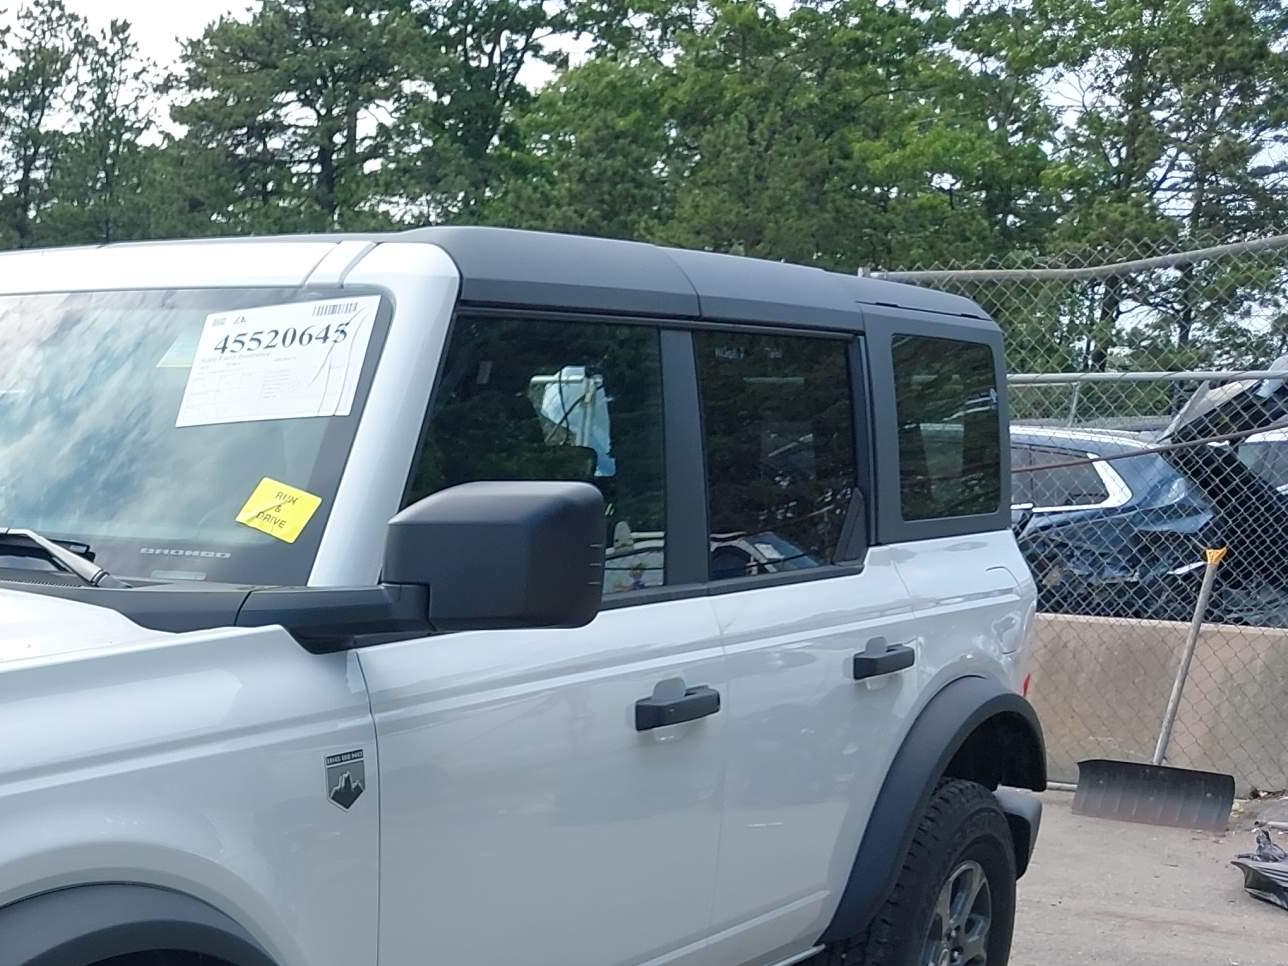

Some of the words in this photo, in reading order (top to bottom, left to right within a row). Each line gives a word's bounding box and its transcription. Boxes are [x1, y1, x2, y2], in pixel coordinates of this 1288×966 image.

[213, 321, 349, 354] 45520645
[274, 491, 299, 506] RUN
[274, 504, 282, 513] &
[255, 511, 287, 529] DRIVE
